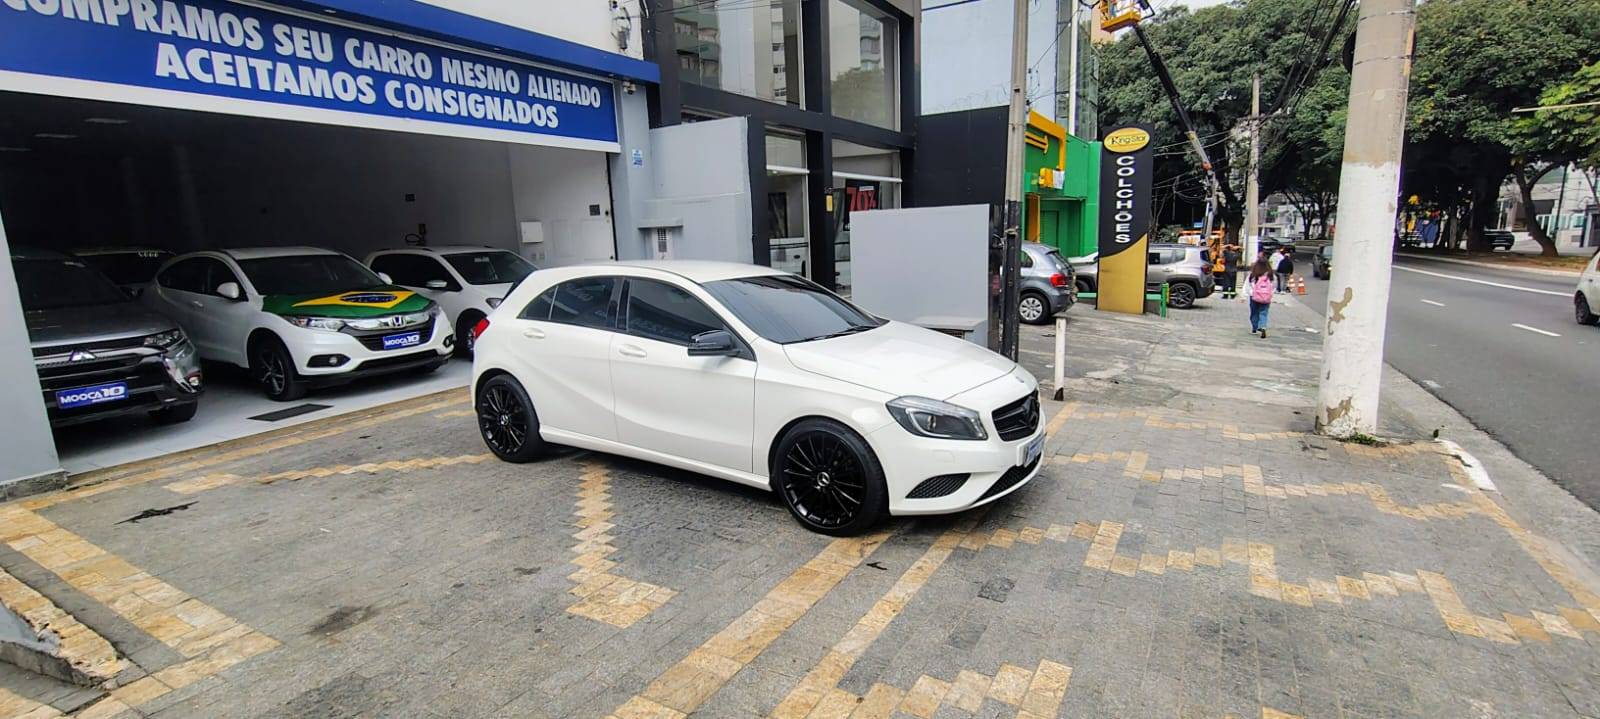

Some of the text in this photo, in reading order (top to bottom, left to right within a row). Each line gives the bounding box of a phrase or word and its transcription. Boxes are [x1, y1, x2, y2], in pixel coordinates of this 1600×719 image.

[155, 43, 559, 129] ACEITAMOS CONSIGNADOS
[272, 23, 334, 63] SEU
[345, 38, 432, 80] CARRO
[442, 57, 520, 95] MESMO
[527, 74, 601, 109] ALIENADO
[1114, 155, 1136, 243] COLCHÕES
